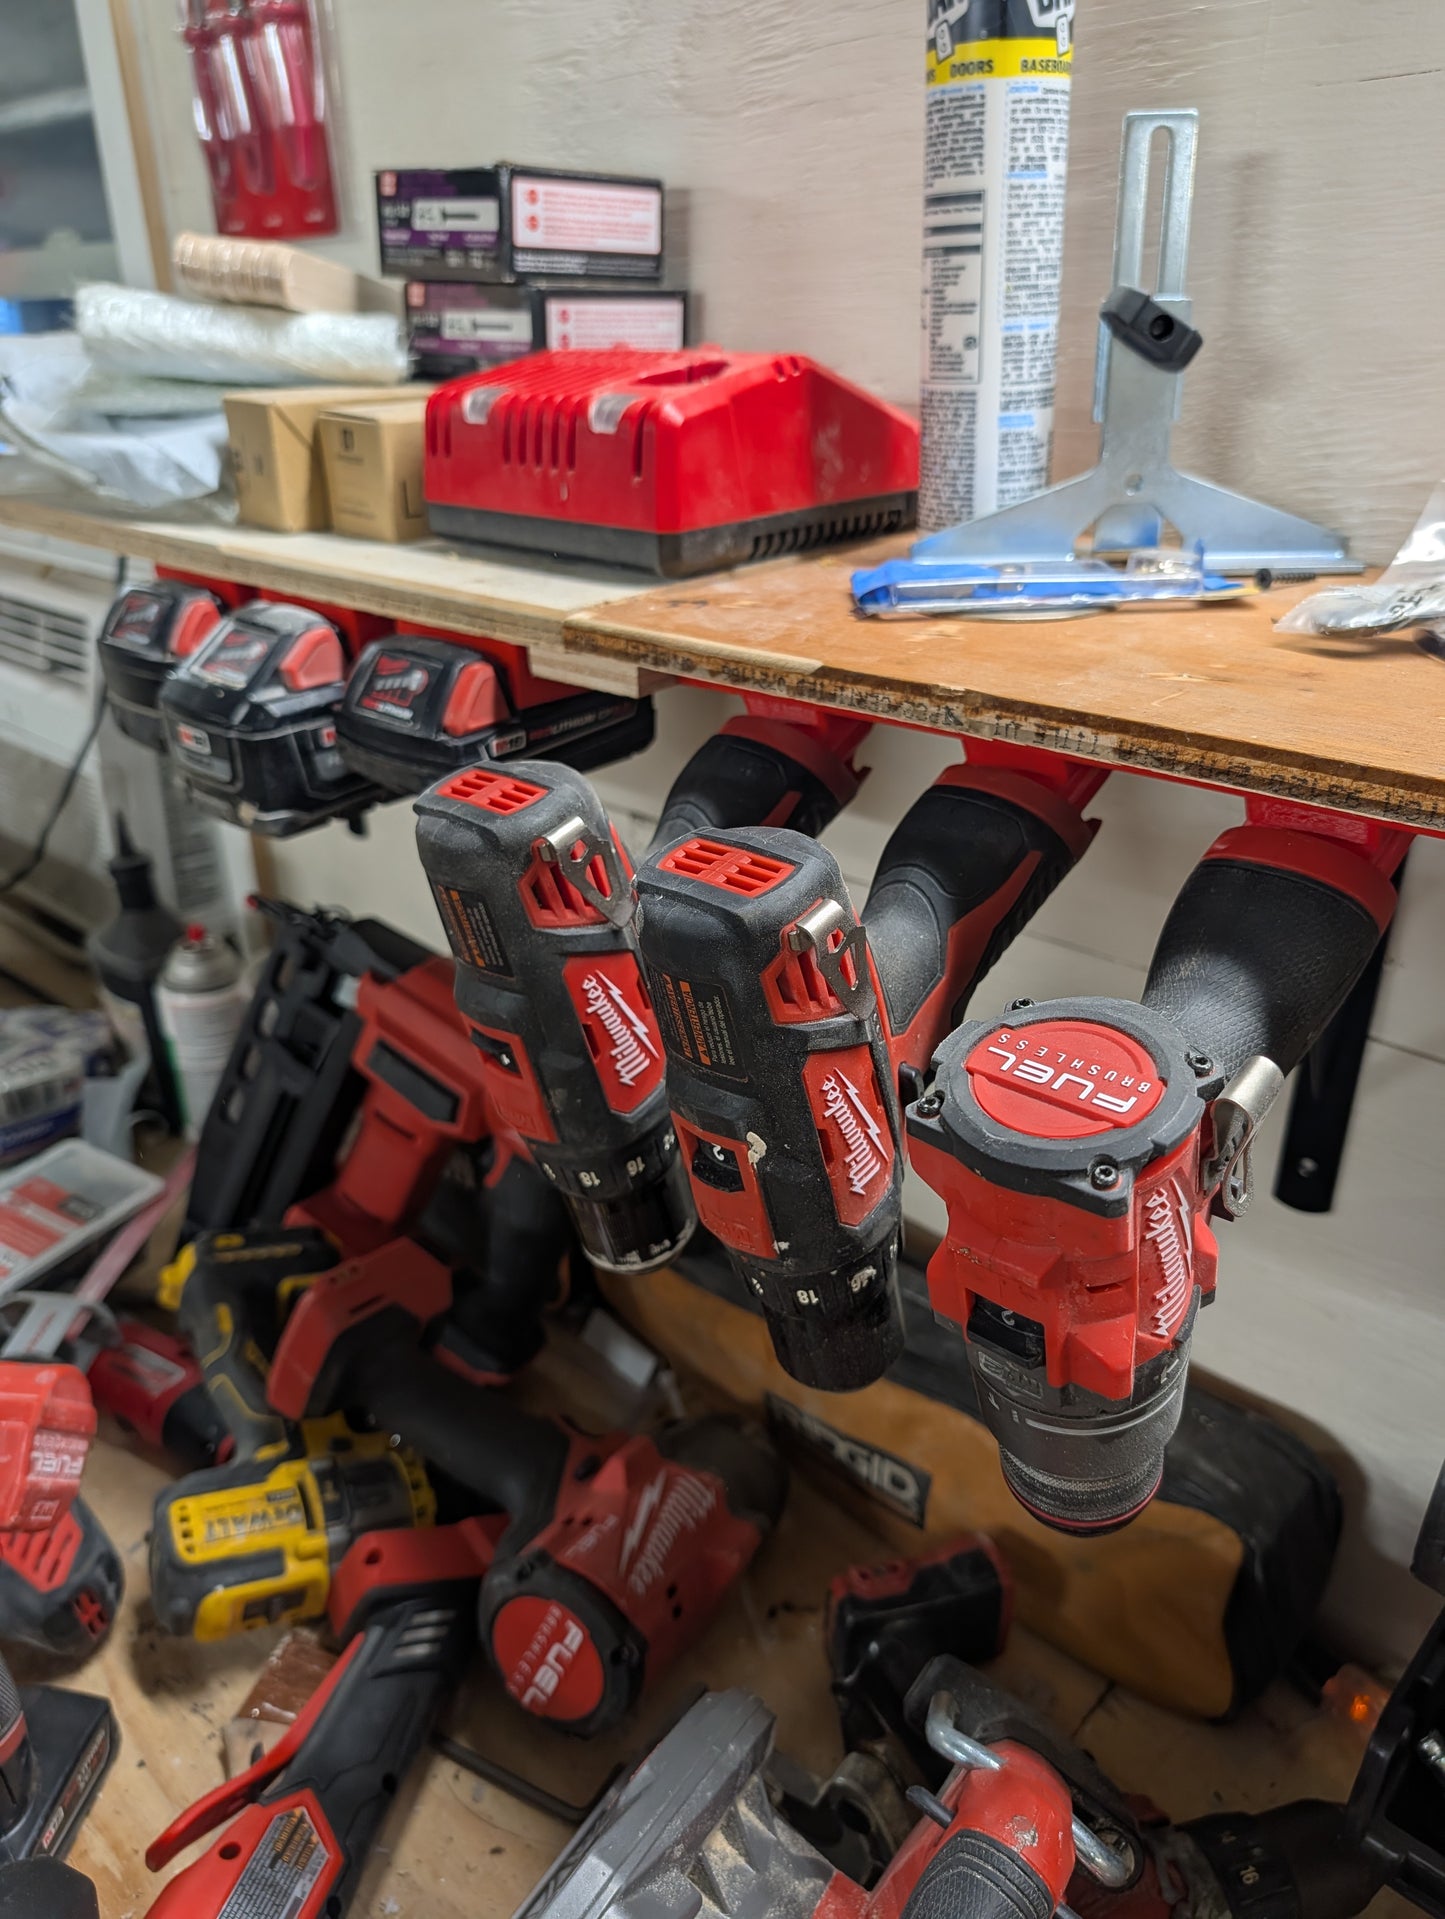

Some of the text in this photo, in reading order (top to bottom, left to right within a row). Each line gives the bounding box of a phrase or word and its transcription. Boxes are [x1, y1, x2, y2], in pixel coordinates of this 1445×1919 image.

[949, 59, 995, 78] DOORS
[1032, 726, 1100, 756] TITLE
[582, 974, 651, 1087] Milwaukee
[682, 990, 706, 1051] ADVERTENCIA
[987, 1045, 1138, 1114] FUEL
[997, 1032, 1153, 1094] BRUSHLESS
[821, 1074, 881, 1196] Milwaukee
[578, 1170, 601, 1188] 18
[626, 1156, 646, 1178] 16
[1144, 1188, 1187, 1337] Milwaukee
[796, 1289, 819, 1305] 18
[30, 1451, 85, 1475] FUEL
[628, 1473, 716, 1597] Milwaukee
[520, 1618, 585, 1706] FUEL
[1240, 1865, 1260, 1884] 16
